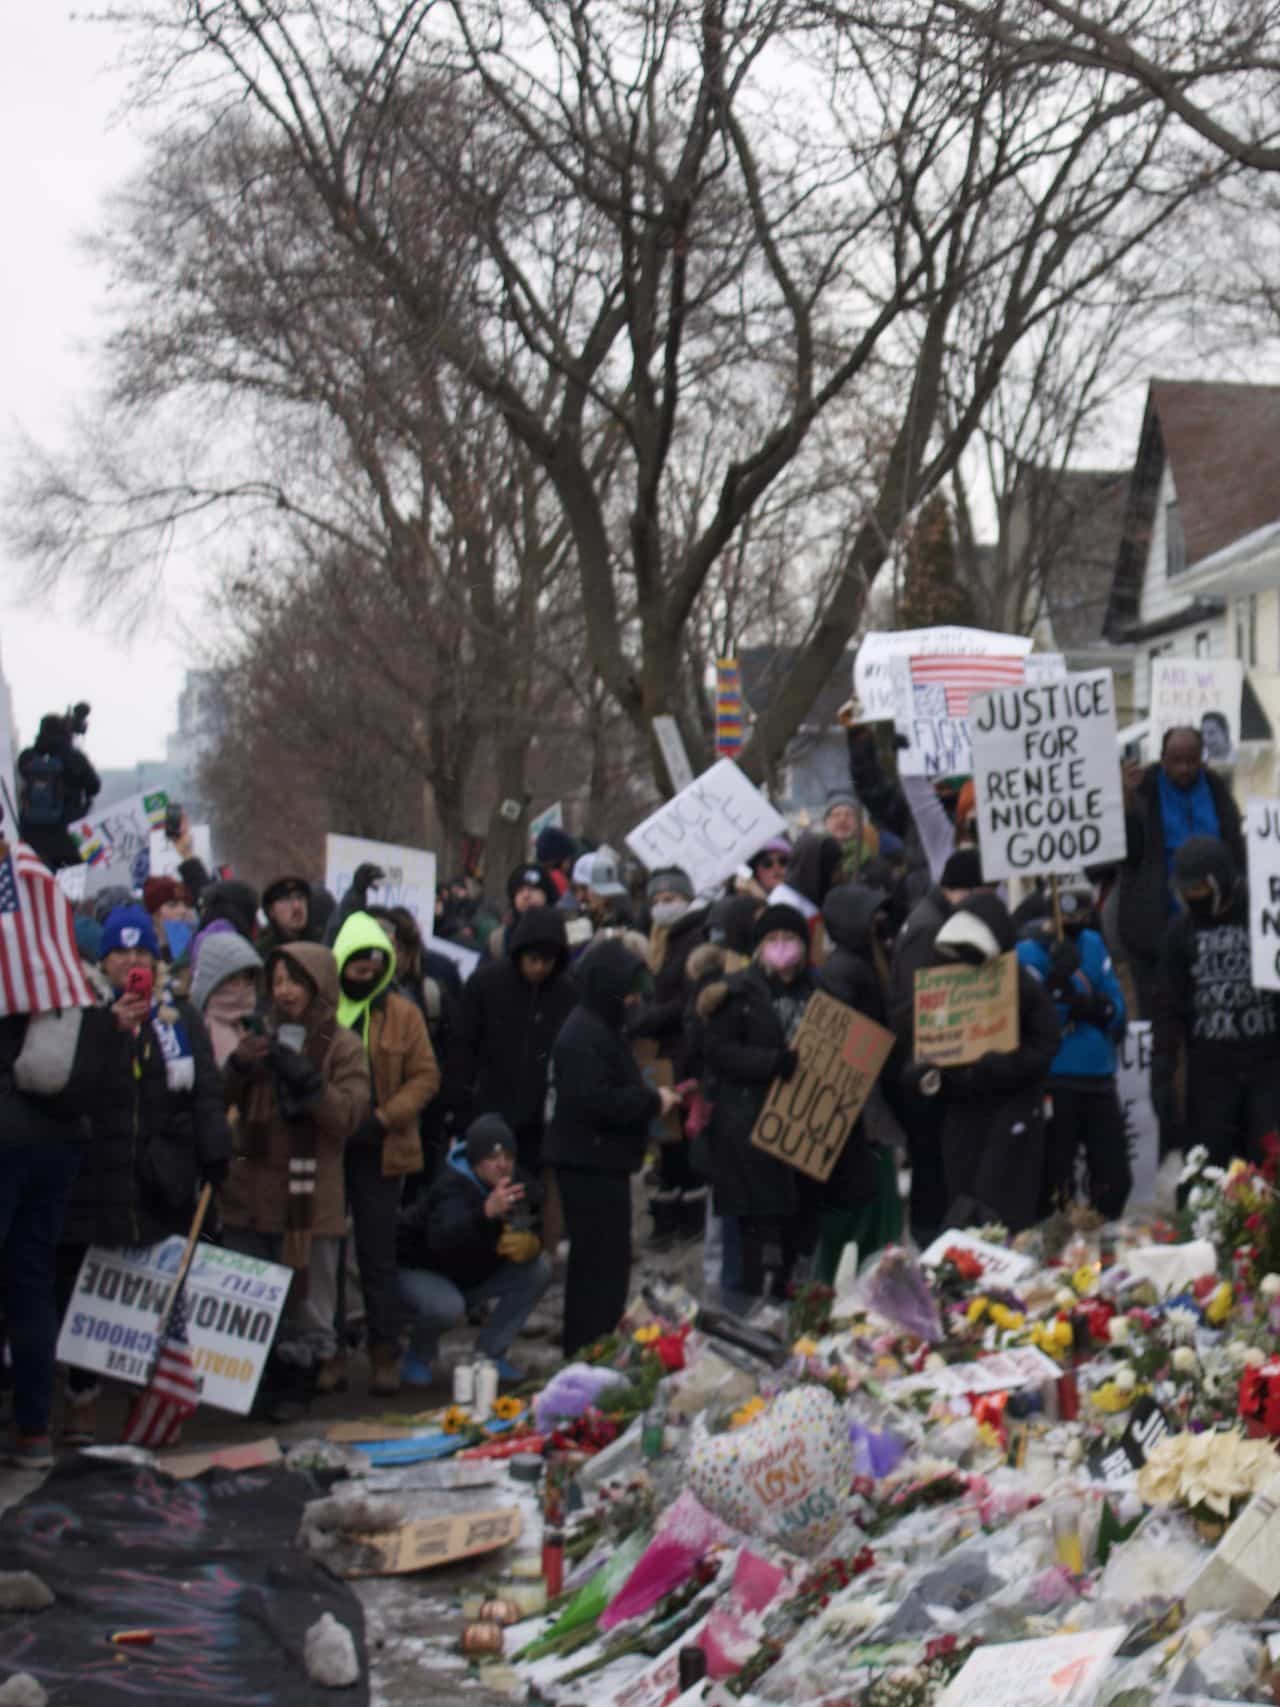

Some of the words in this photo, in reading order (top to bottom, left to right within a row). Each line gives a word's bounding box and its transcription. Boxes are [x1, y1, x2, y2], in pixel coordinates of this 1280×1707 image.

[977, 678, 1111, 732] JUSTICE
[1025, 725, 1078, 760] FOR
[986, 758, 1086, 802] RENEE
[641, 783, 723, 857] FUCK
[991, 790, 1103, 832] NICOLE
[1006, 824, 1101, 868] GOOD
